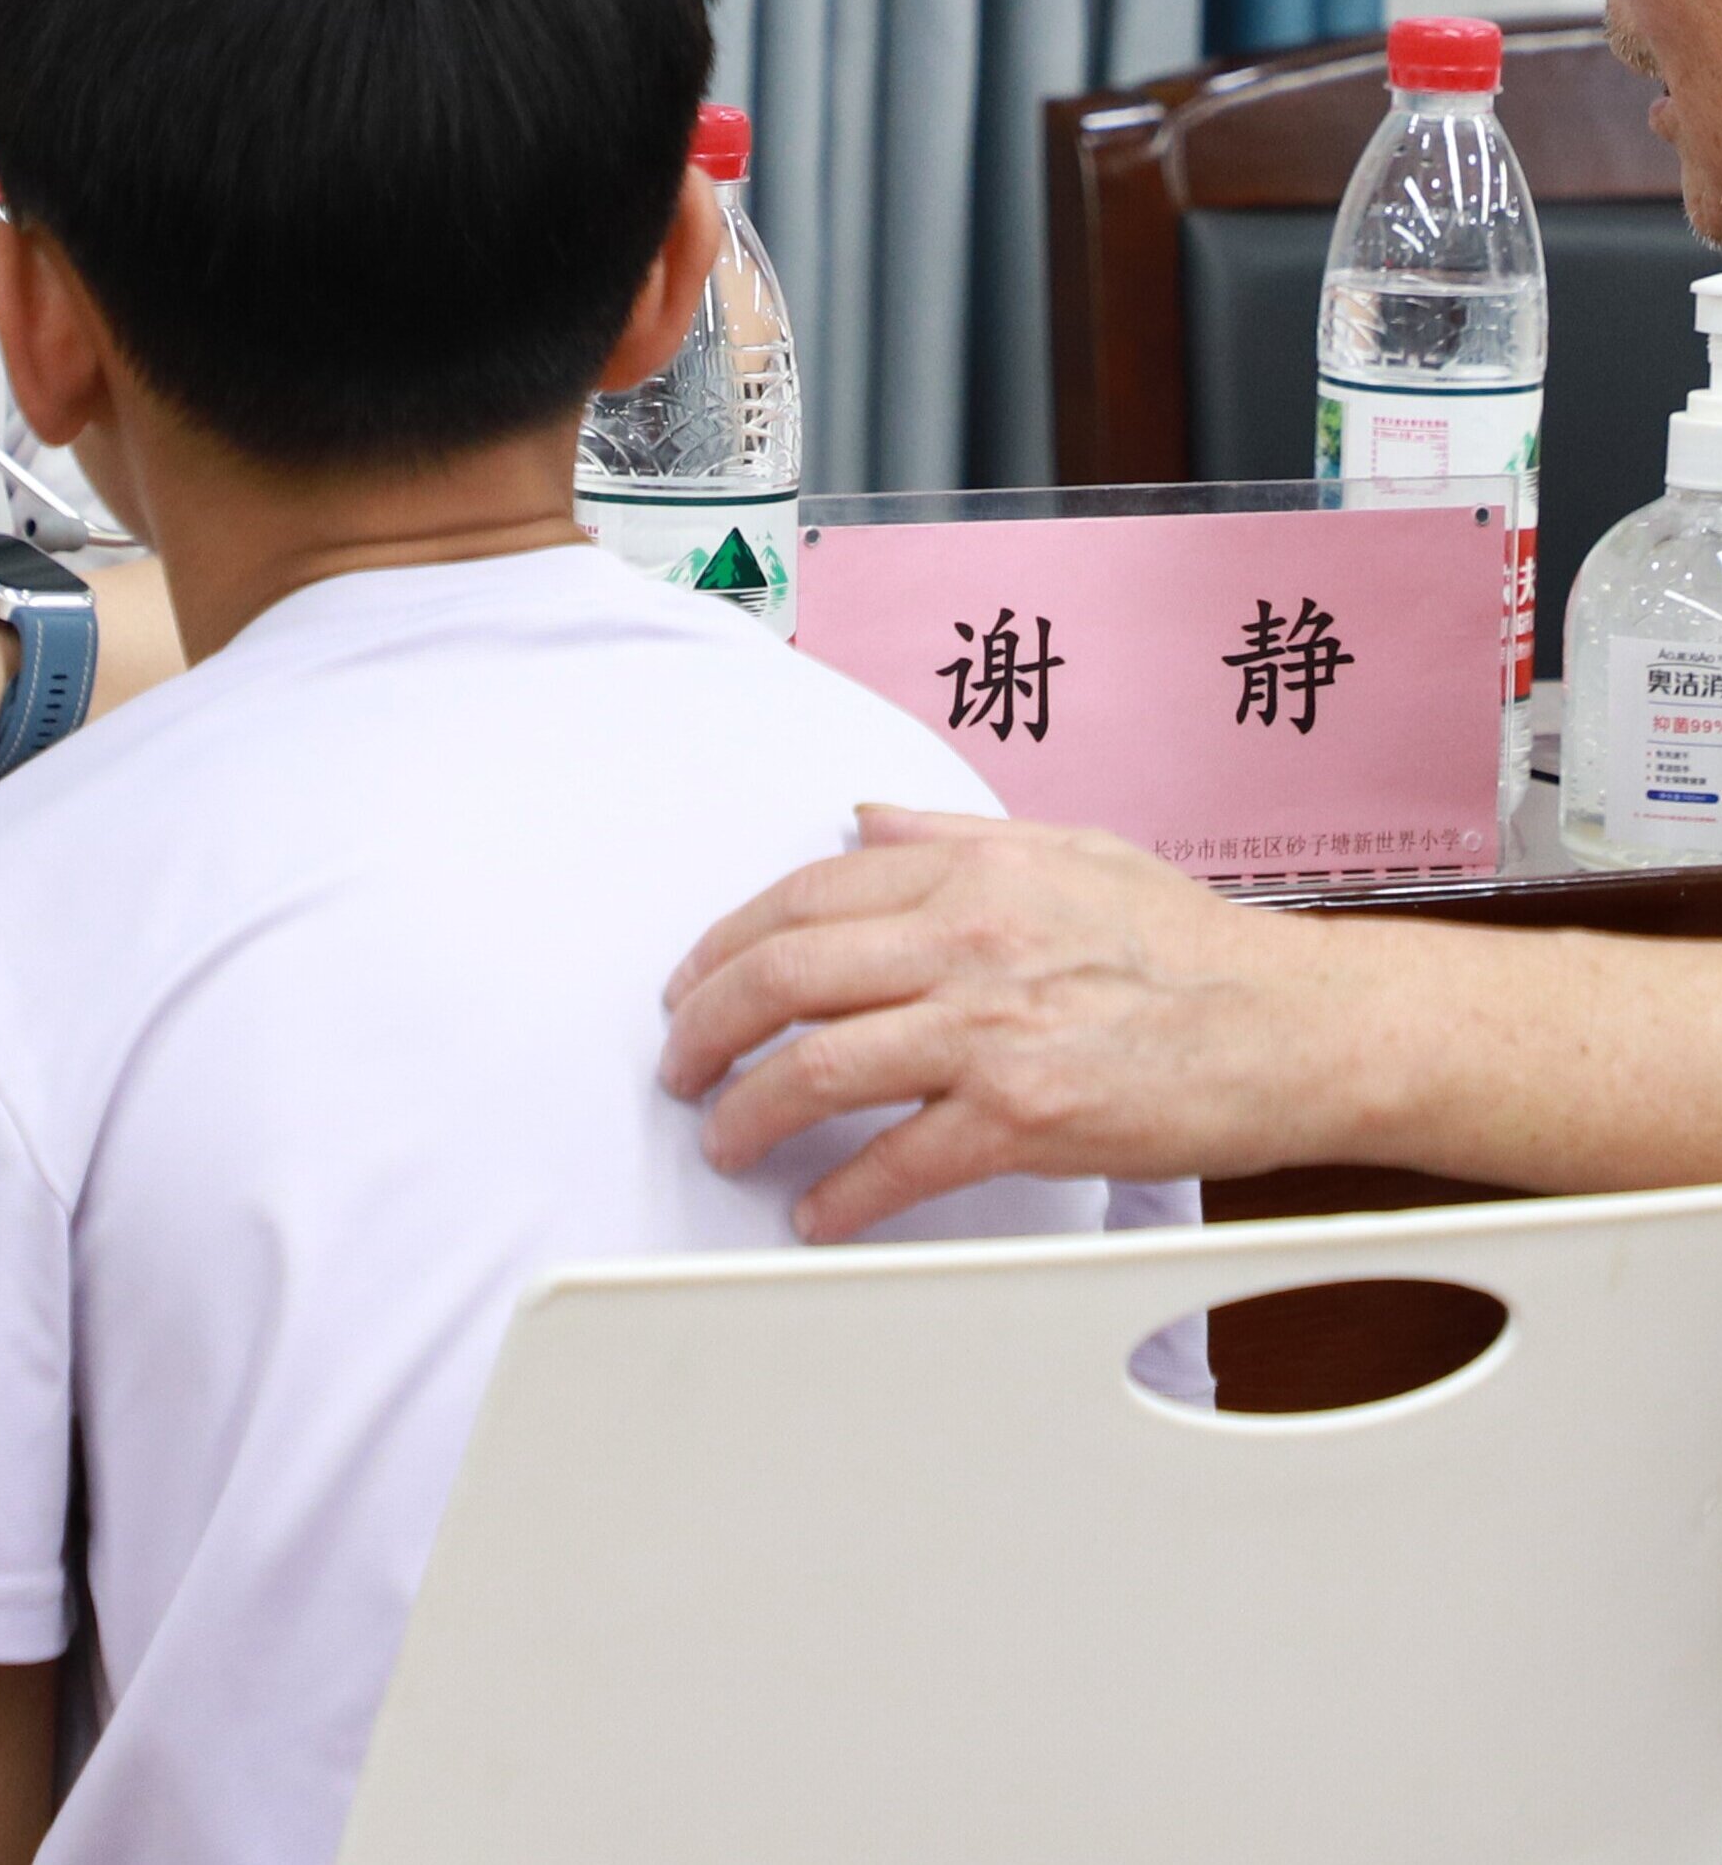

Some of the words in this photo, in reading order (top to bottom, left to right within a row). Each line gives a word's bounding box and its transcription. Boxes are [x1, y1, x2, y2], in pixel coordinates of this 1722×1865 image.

[935, 597, 1355, 743] 谢静
[1154, 828, 1460, 862] 长沙市雨花区砂子塘新世界小学
